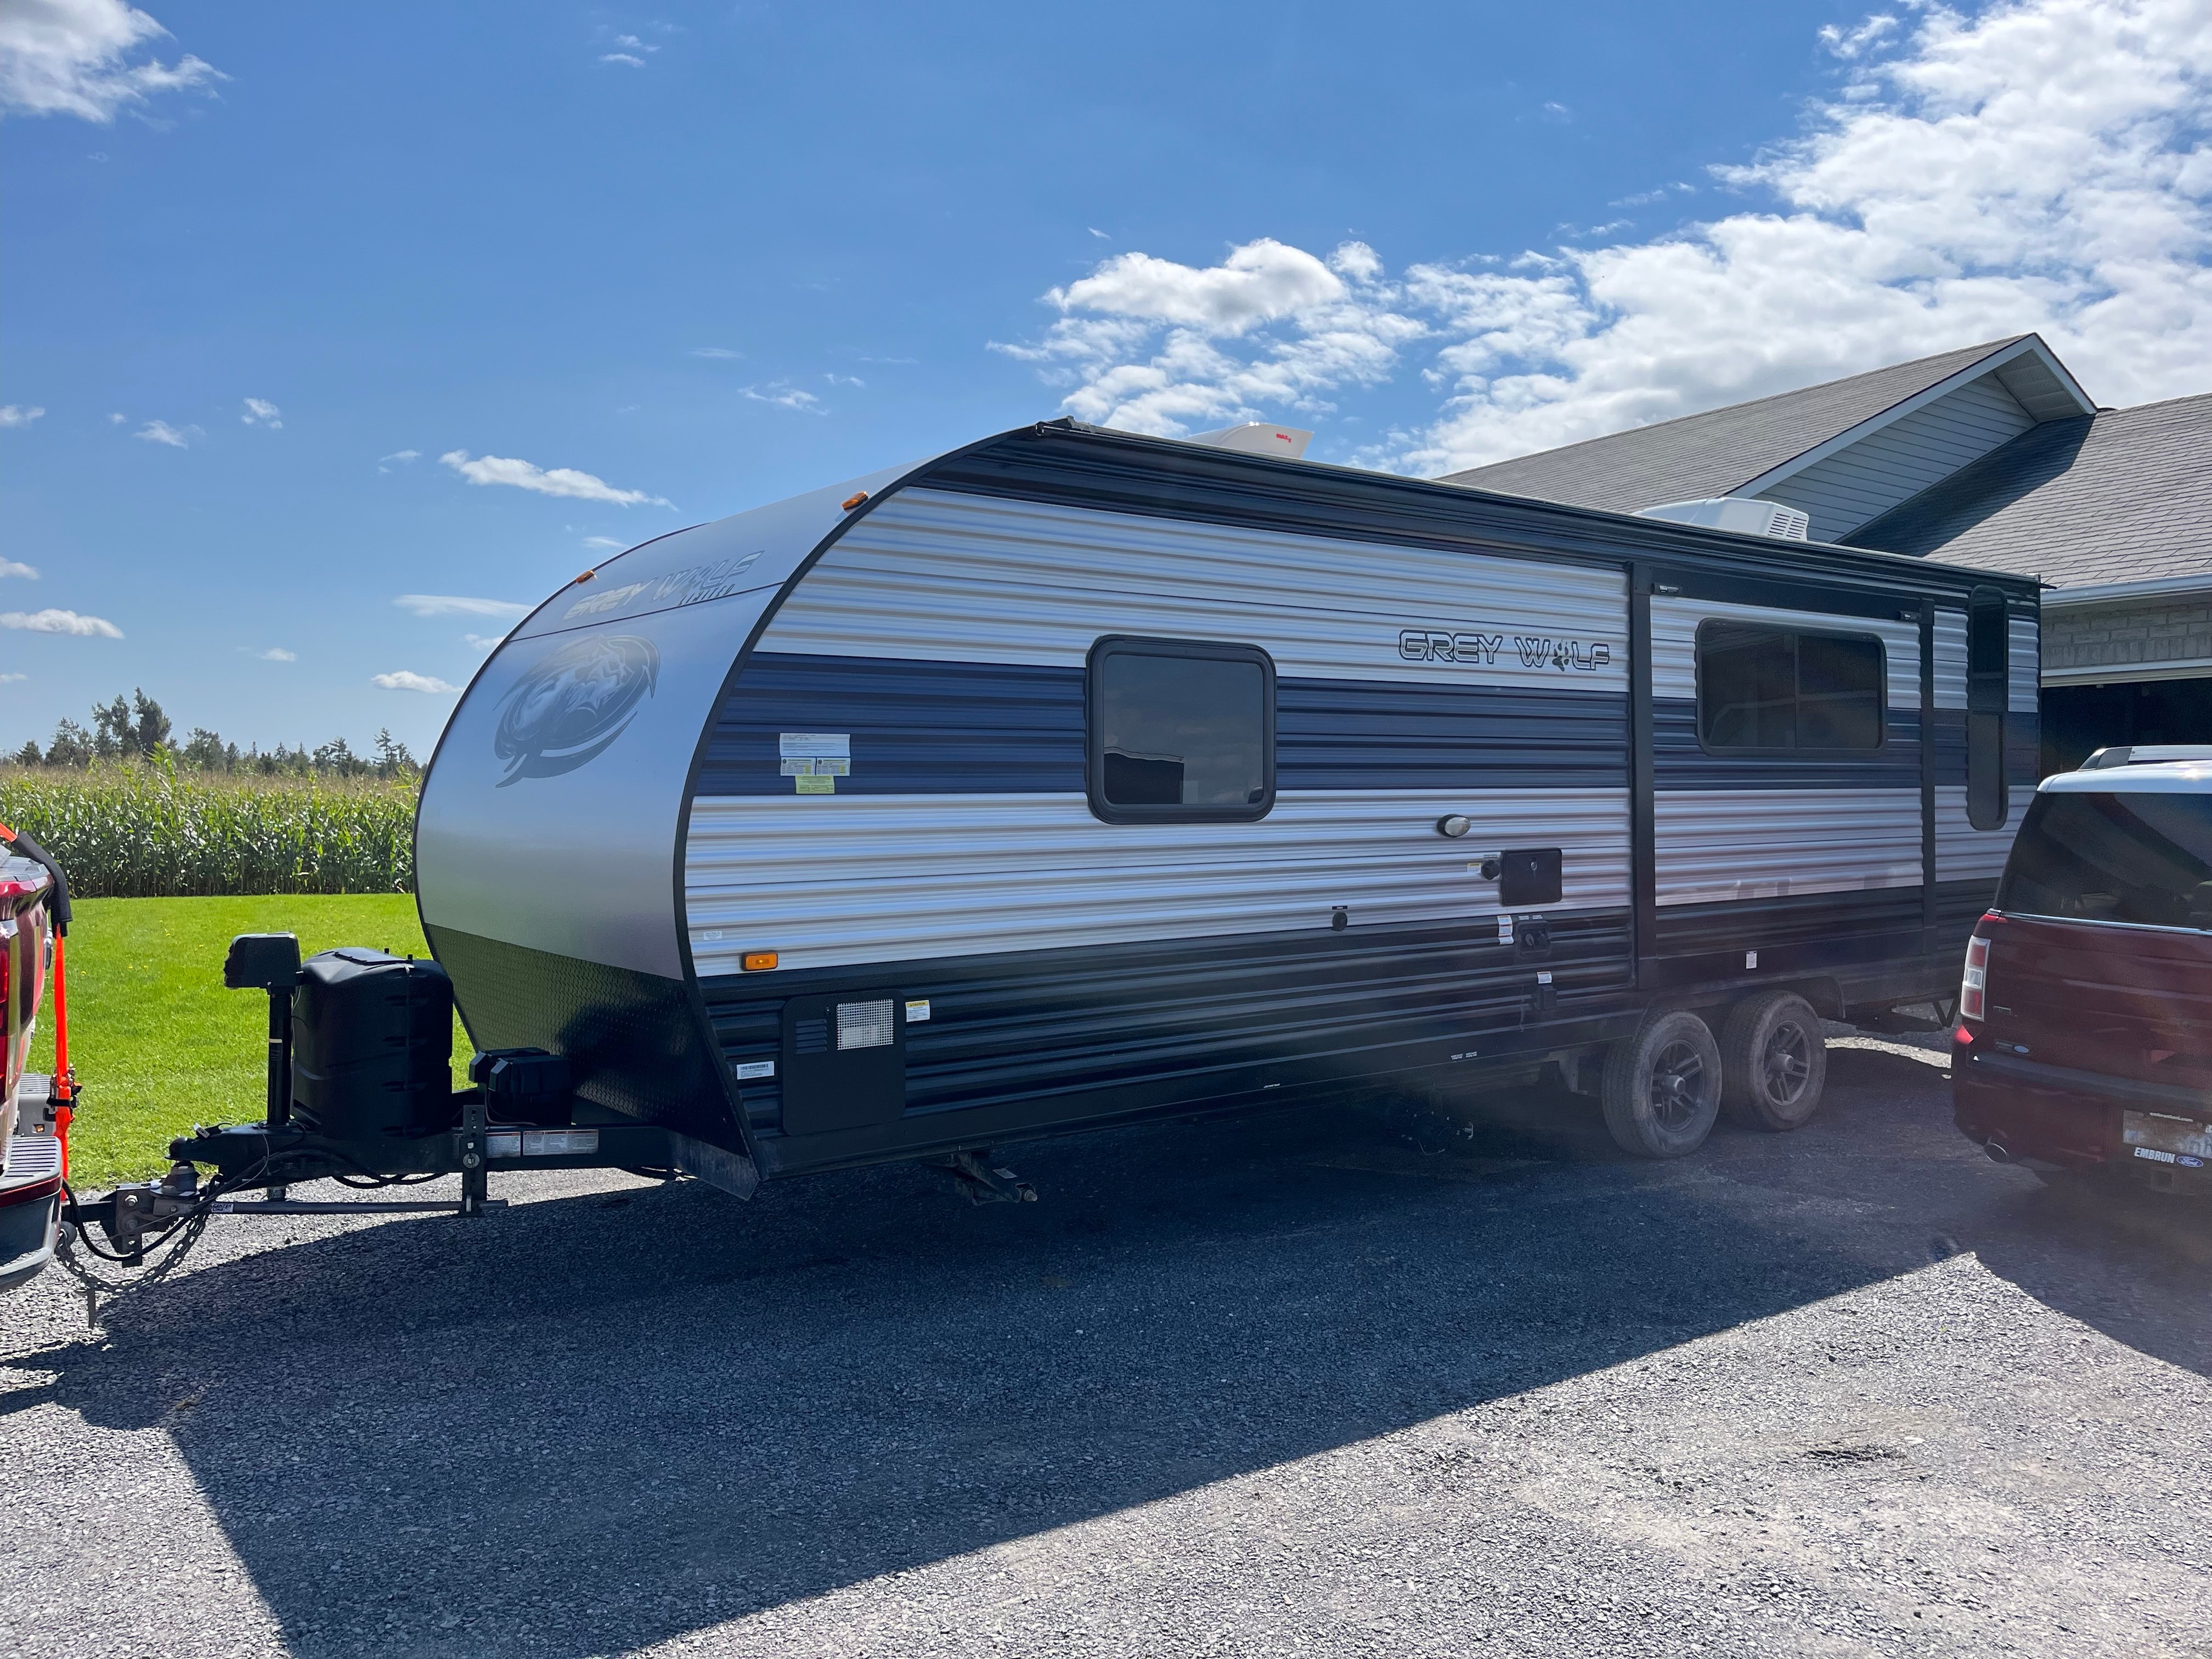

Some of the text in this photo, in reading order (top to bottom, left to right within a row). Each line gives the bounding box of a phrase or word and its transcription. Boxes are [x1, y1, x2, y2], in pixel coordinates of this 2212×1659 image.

[562, 577, 659, 622] GREY
[678, 583, 736, 606] LIMITED
[1399, 629, 1503, 664] GREY
[2134, 1147, 2175, 1164] EMBRUN
